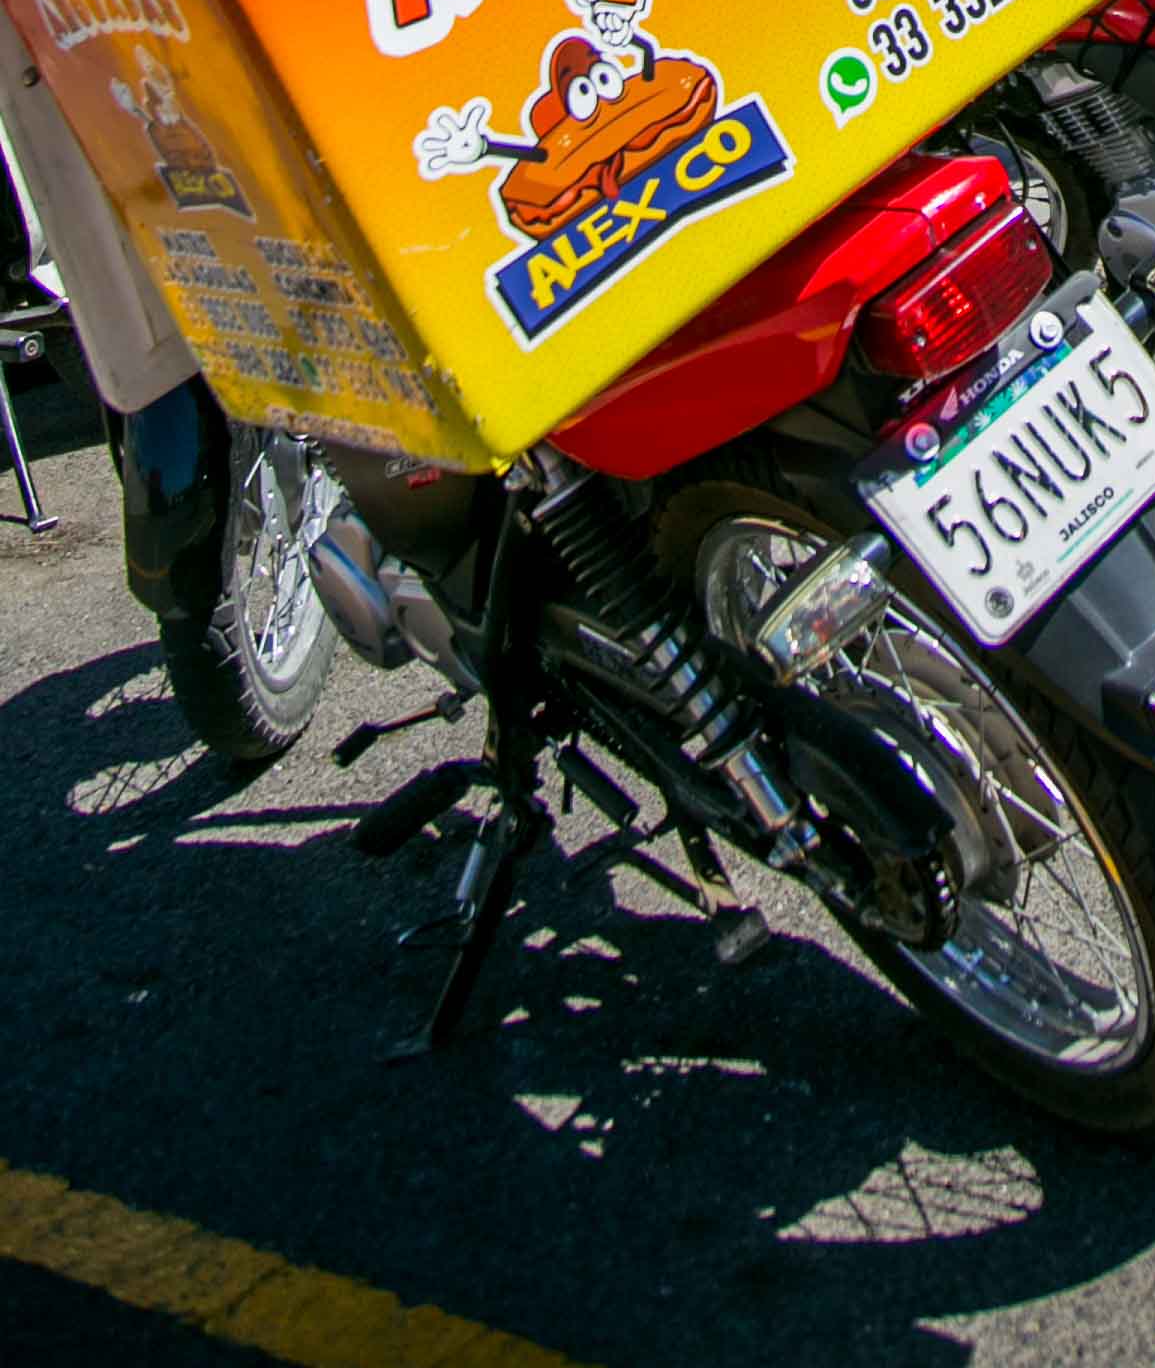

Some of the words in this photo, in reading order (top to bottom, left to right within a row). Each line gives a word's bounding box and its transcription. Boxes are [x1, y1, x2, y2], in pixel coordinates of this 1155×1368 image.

[872, 9, 930, 76] 33
[527, 178, 667, 310] ALEX
[675, 119, 752, 192] CO
[960, 349, 1024, 409] HONDA
[926, 347, 1150, 576] 56NUK5
[1058, 486, 1115, 542] JALISCO
